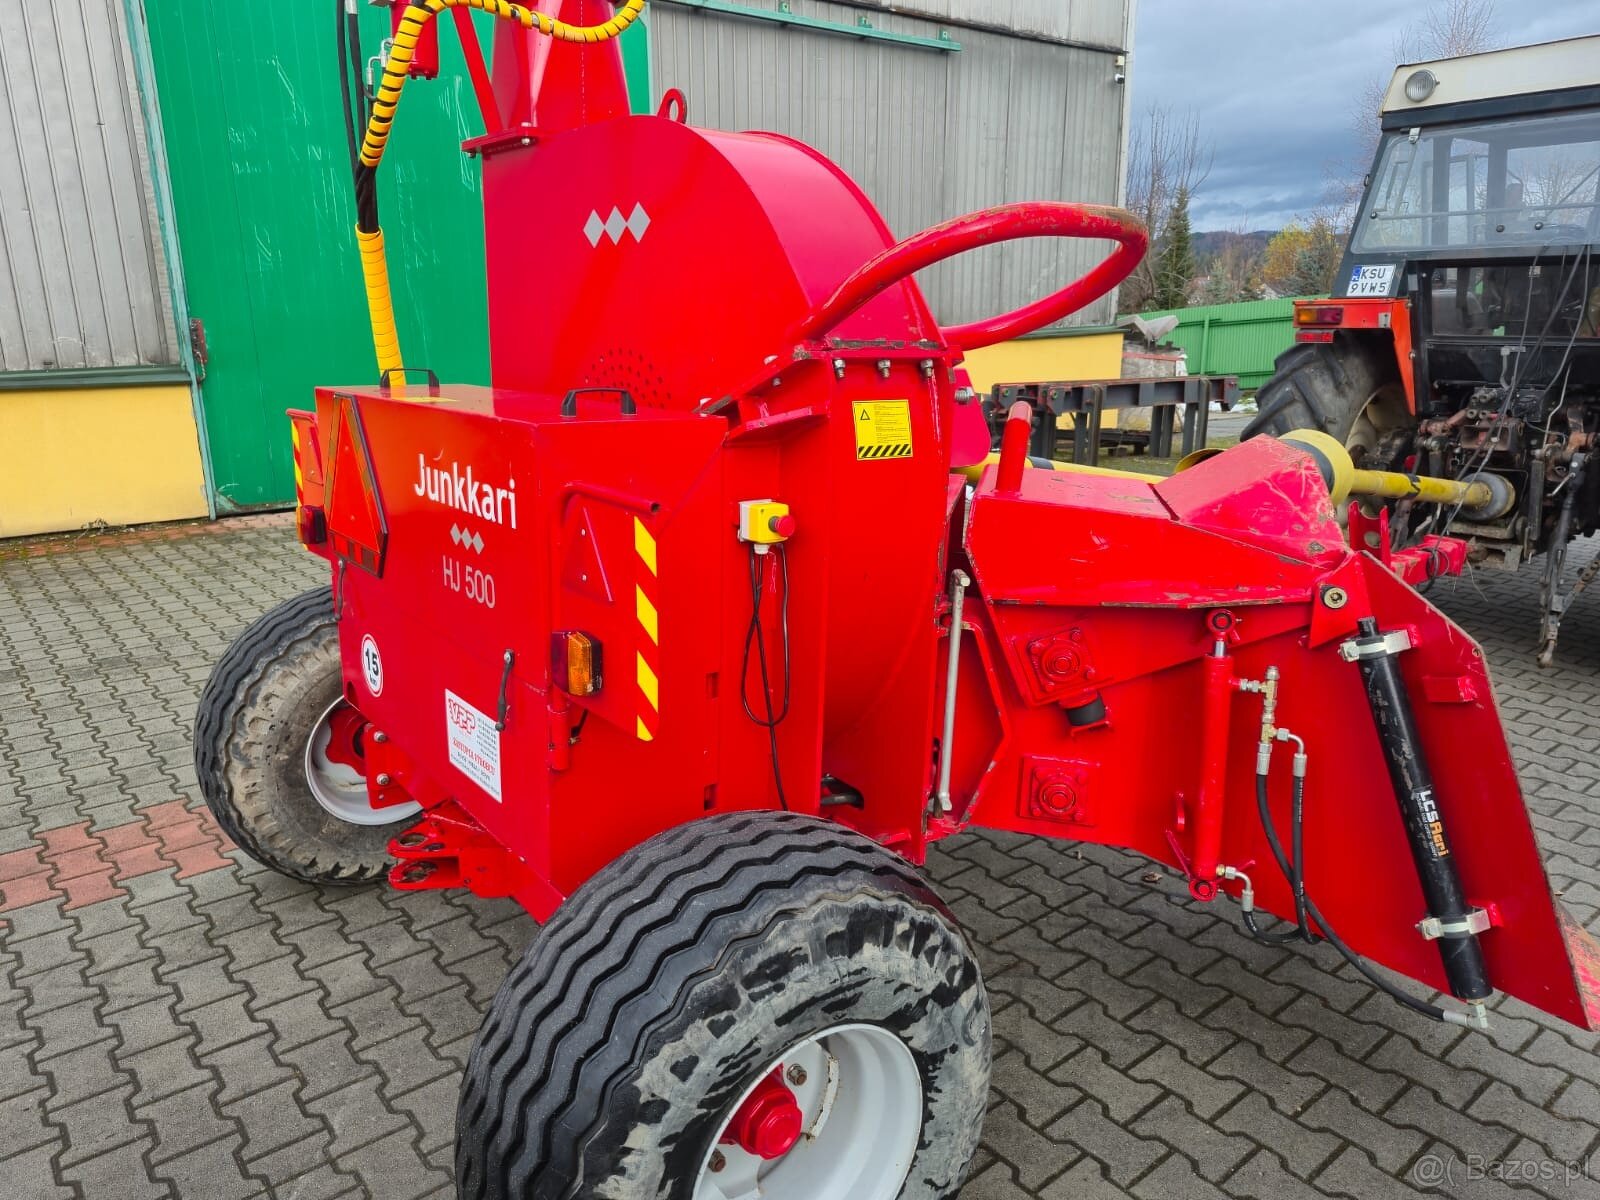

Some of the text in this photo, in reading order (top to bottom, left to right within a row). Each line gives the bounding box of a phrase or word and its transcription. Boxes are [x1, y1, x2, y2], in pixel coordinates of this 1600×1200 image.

[1350, 282, 1387, 294] 9VW5
[1361, 268, 1386, 279] KSU
[414, 453, 517, 530] Junkkari
[443, 555, 495, 608] HJ 500
[365, 648, 379, 677] 15
